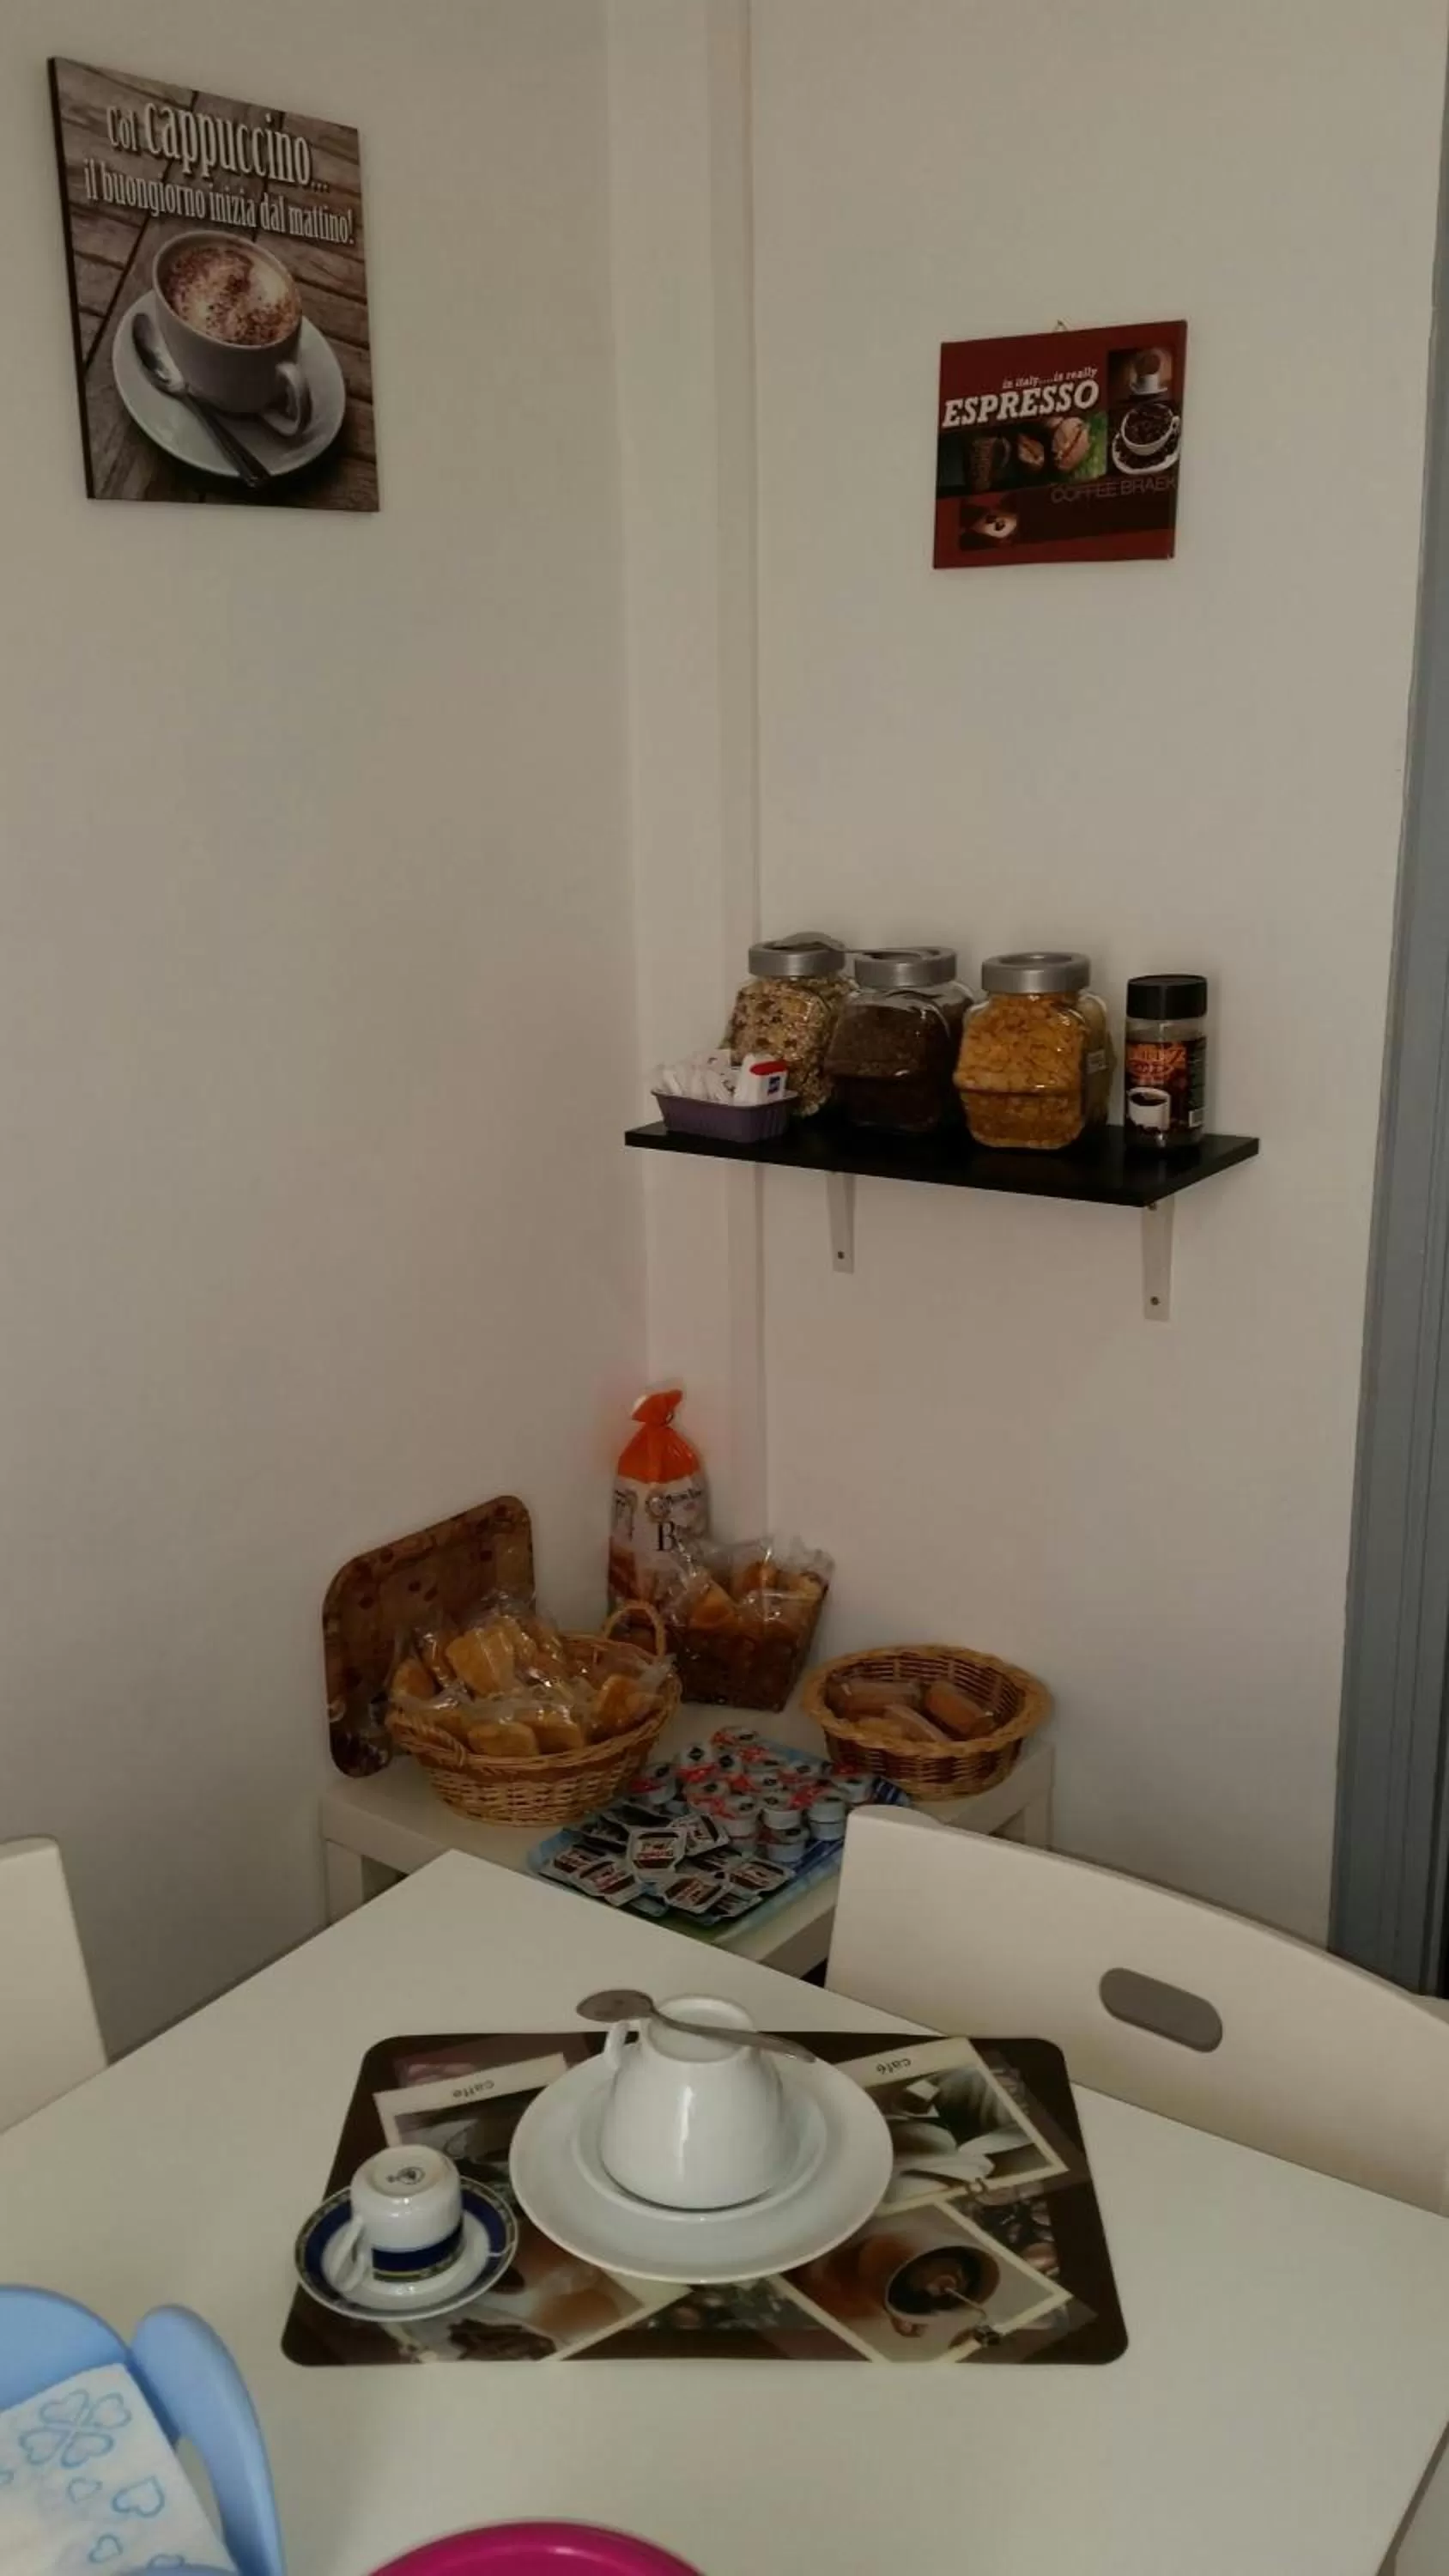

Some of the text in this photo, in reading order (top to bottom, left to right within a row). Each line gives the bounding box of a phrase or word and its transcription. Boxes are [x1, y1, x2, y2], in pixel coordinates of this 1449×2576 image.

[106, 105, 137, 151] Col
[83, 158, 355, 245] il buongiorno inizia dal mattino!
[1065, 366, 1098, 380] really
[942, 380, 1100, 428] ESPRESSO
[1050, 481, 1119, 504] COFFEE
